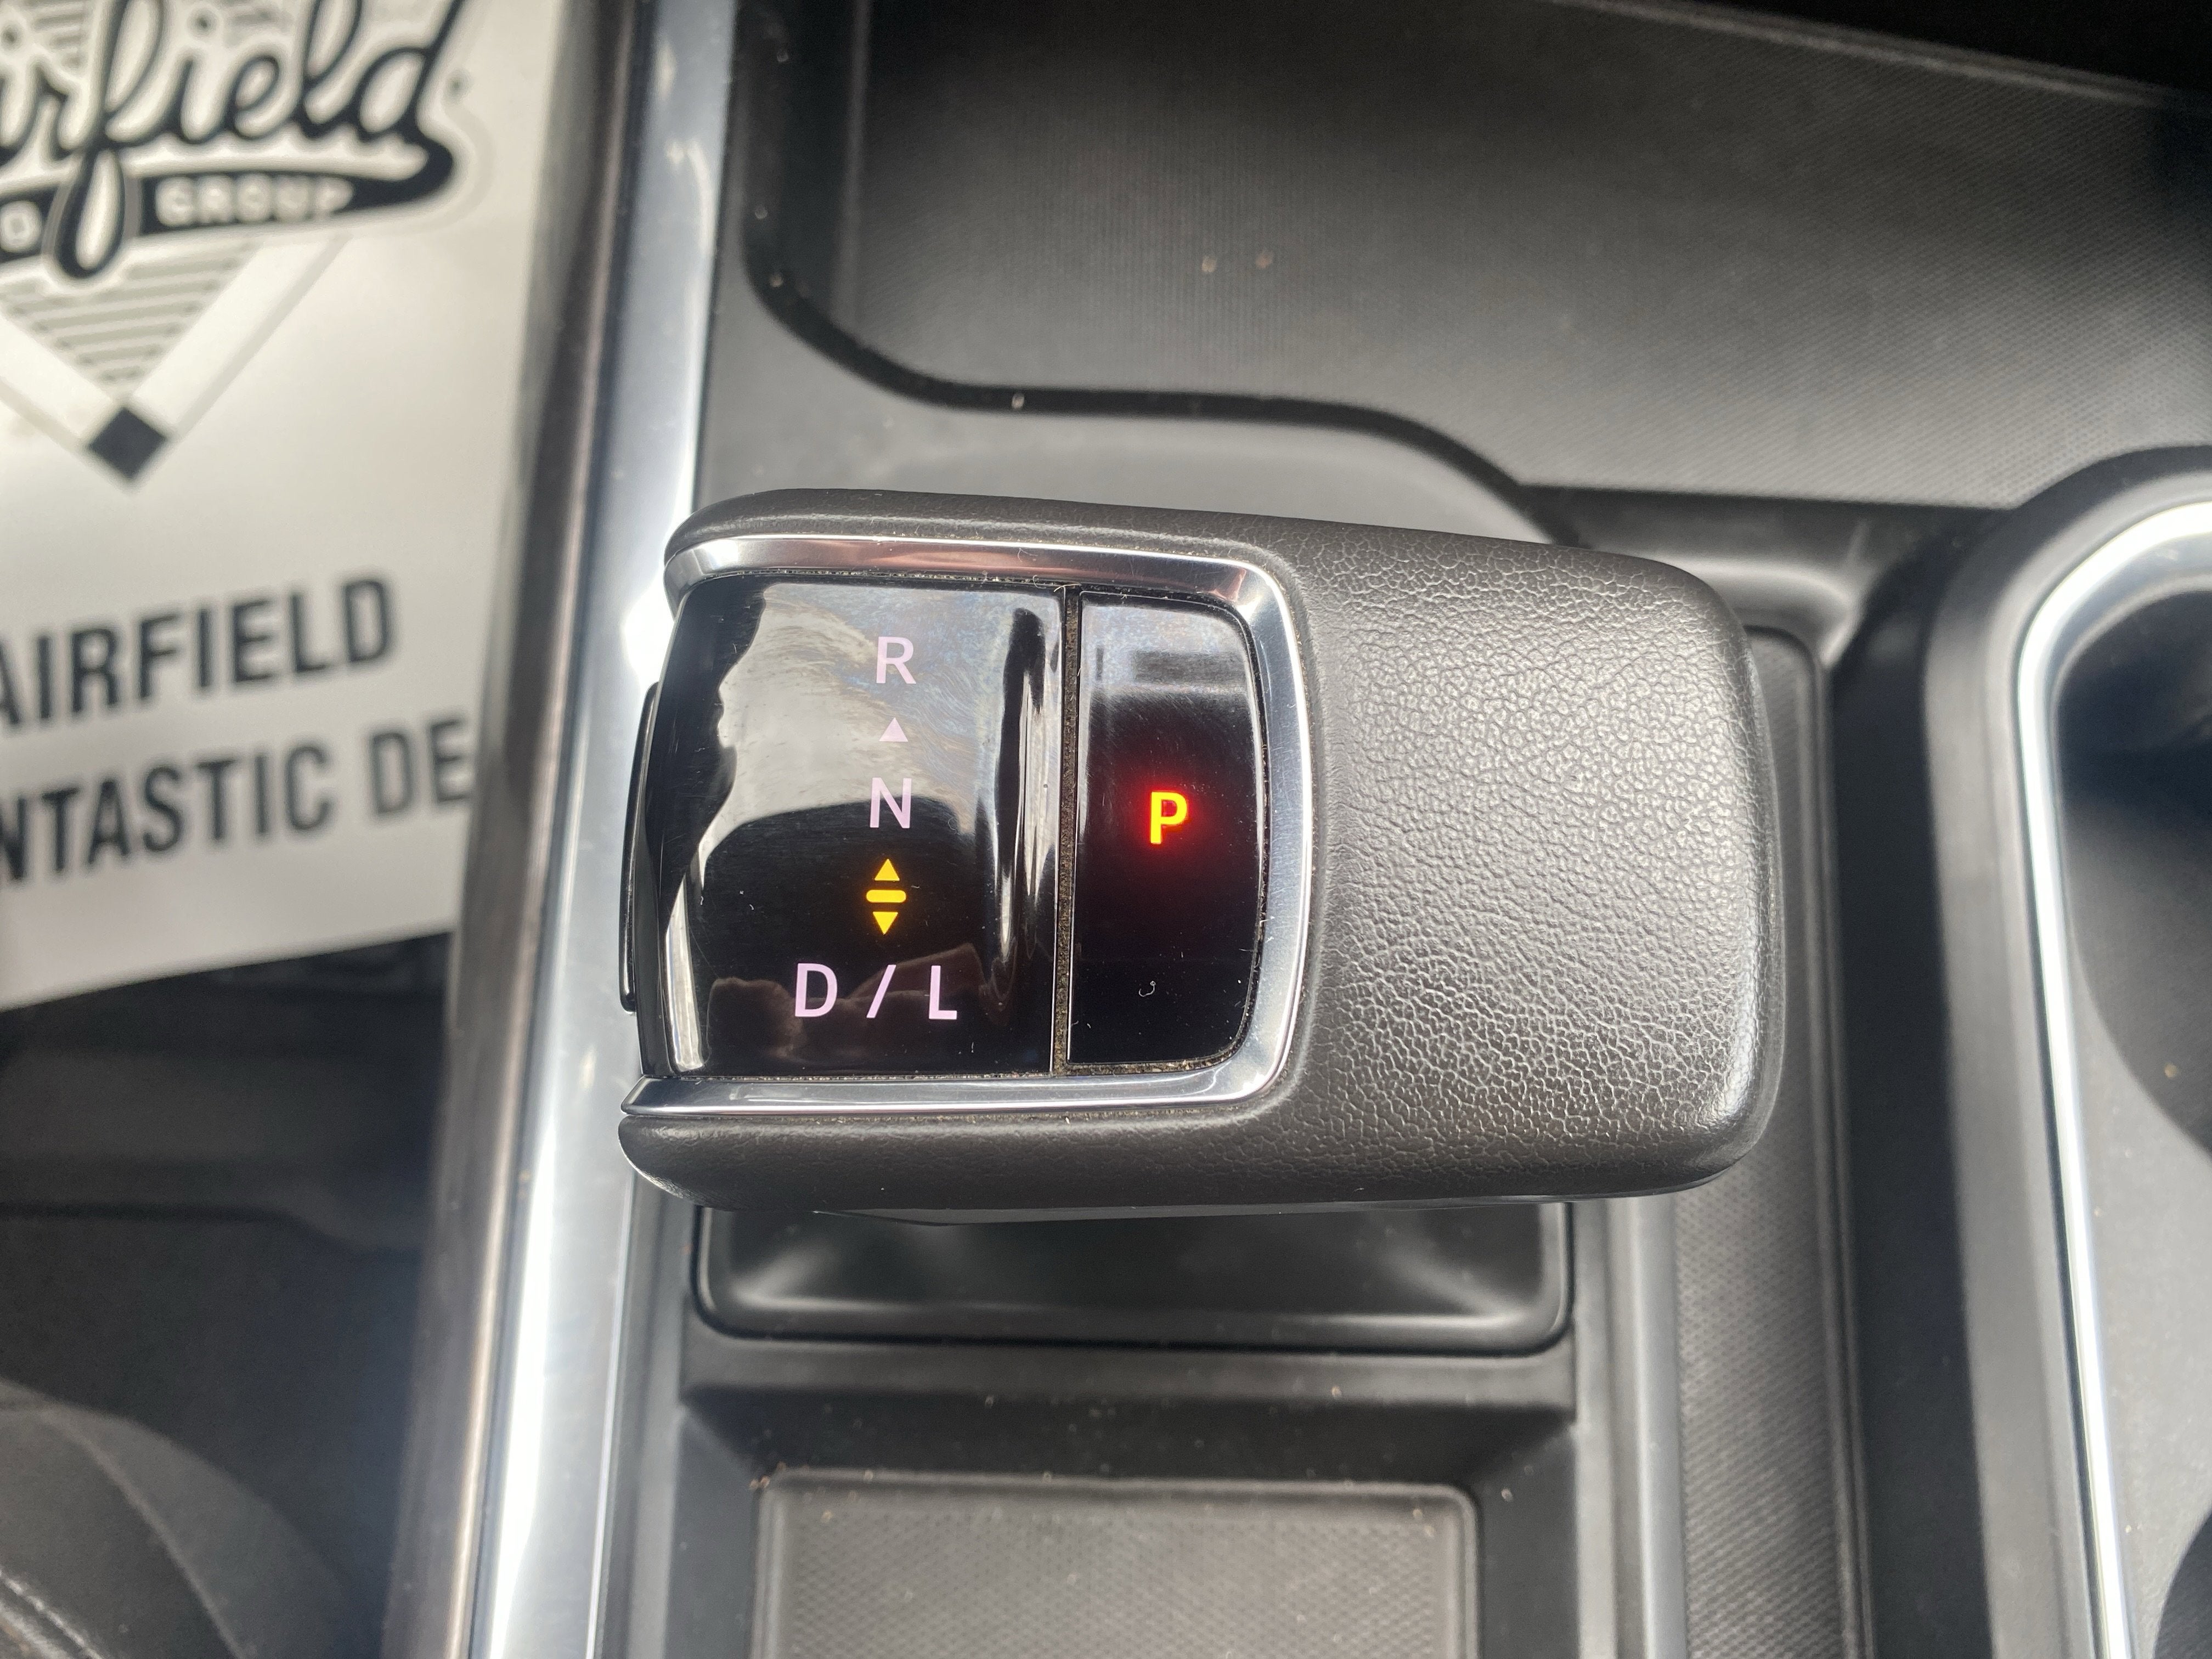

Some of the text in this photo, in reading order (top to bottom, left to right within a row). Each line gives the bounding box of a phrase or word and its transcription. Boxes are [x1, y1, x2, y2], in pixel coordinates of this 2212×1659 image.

[155, 173, 354, 227] GROUP
[876, 636, 917, 685] R
[869, 777, 912, 829] N
[1149, 790, 1189, 845] P
